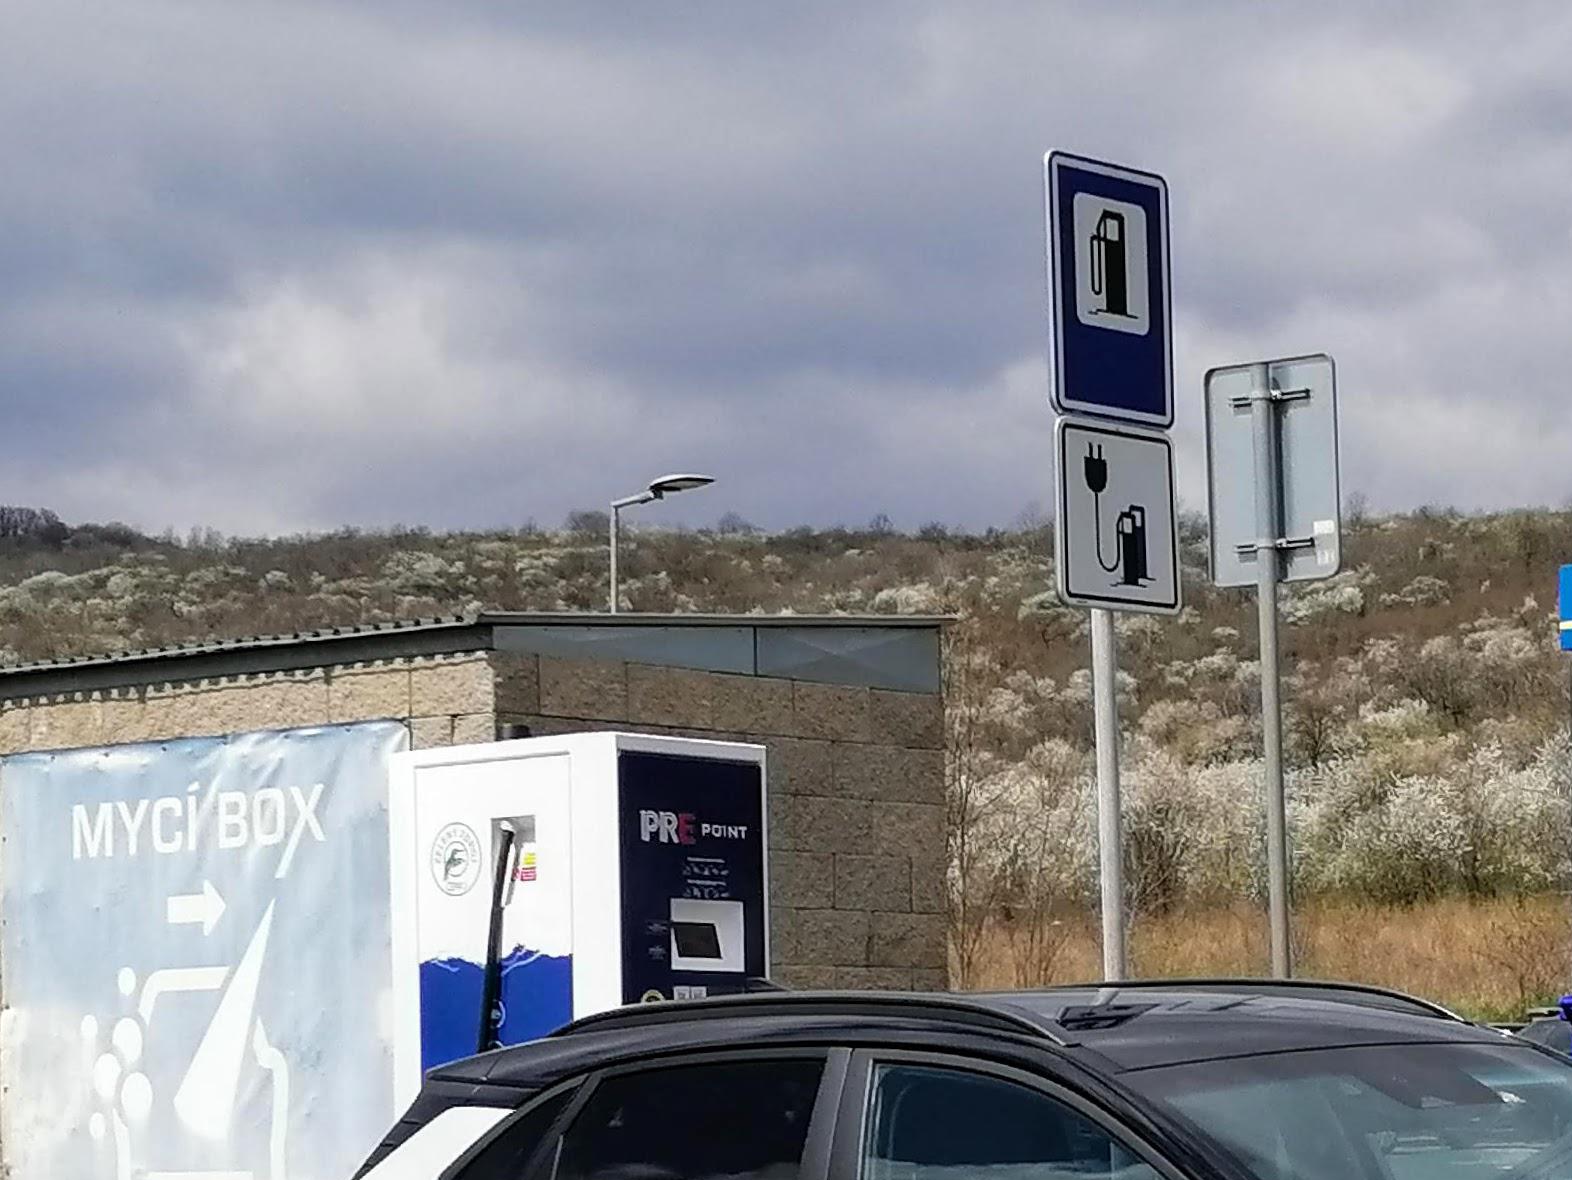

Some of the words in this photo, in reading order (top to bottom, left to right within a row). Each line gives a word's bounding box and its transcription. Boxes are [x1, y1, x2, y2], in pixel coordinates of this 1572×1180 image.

[72, 781, 200, 860] MYCÍ
[217, 783, 327, 879] BOX
[640, 809, 697, 845] PRE
[701, 823, 748, 839] POINT
